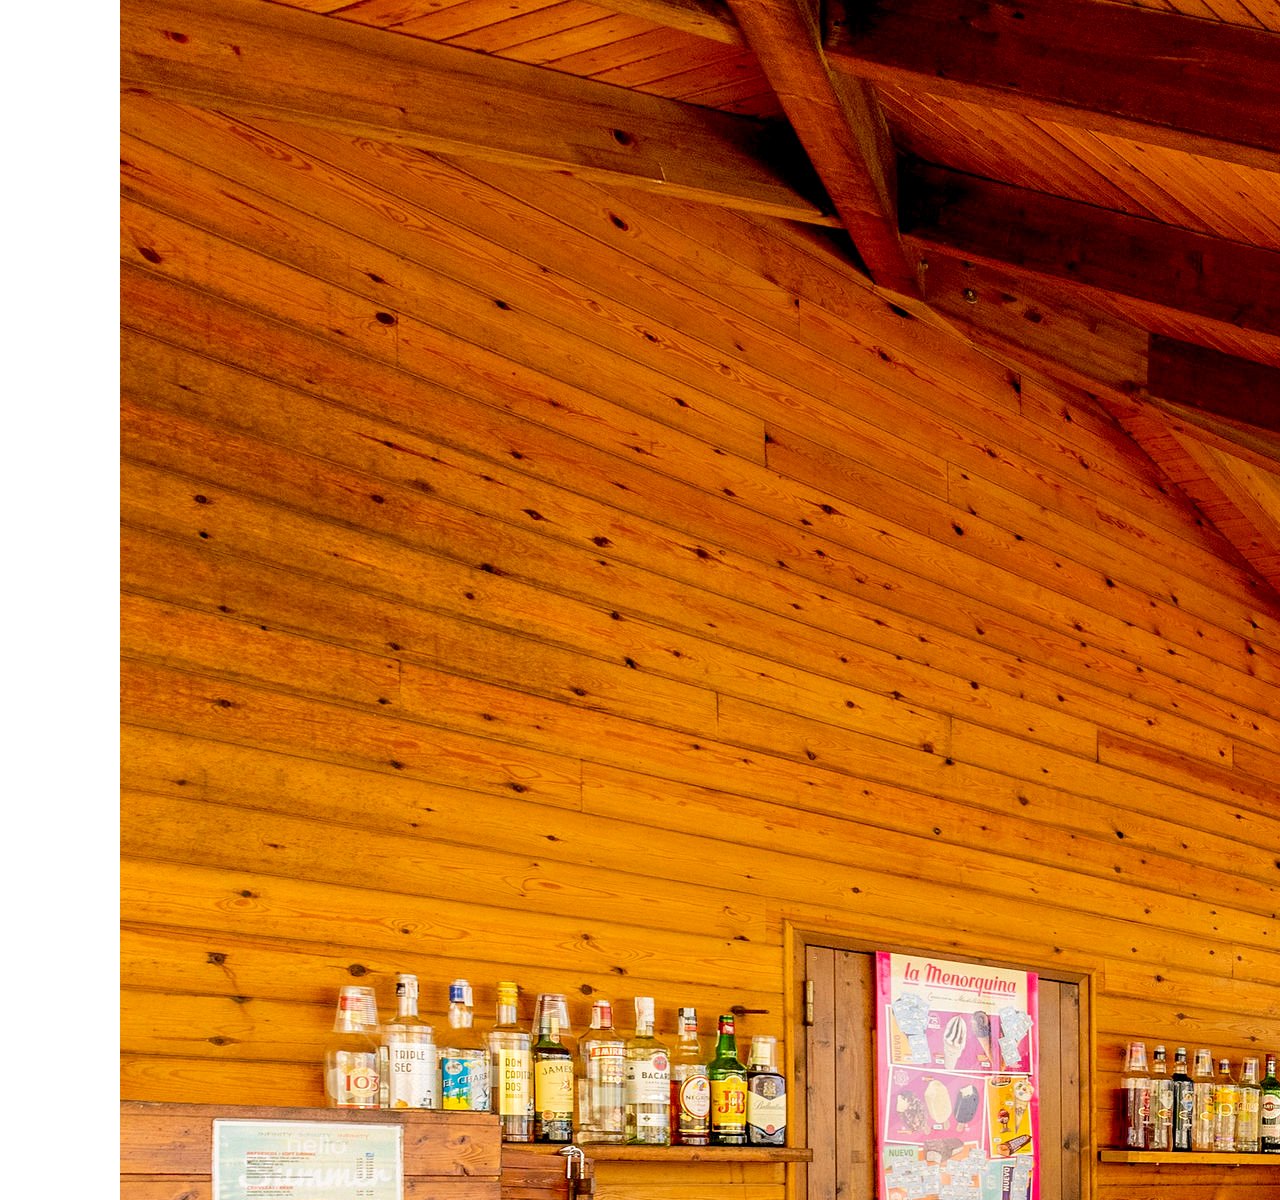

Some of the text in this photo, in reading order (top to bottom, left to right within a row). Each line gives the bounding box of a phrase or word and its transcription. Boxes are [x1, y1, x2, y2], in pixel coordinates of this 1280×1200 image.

[904, 962, 1016, 997] la Menorquina
[395, 1050, 425, 1061] TRIPLE
[394, 1062, 412, 1073] SEC
[505, 1058, 522, 1068] RON
[345, 1075, 379, 1092] 103
[505, 1082, 521, 1092] ROS
[888, 1149, 914, 1157] NUEVO
[1003, 1166, 1011, 1192] NUEVO
